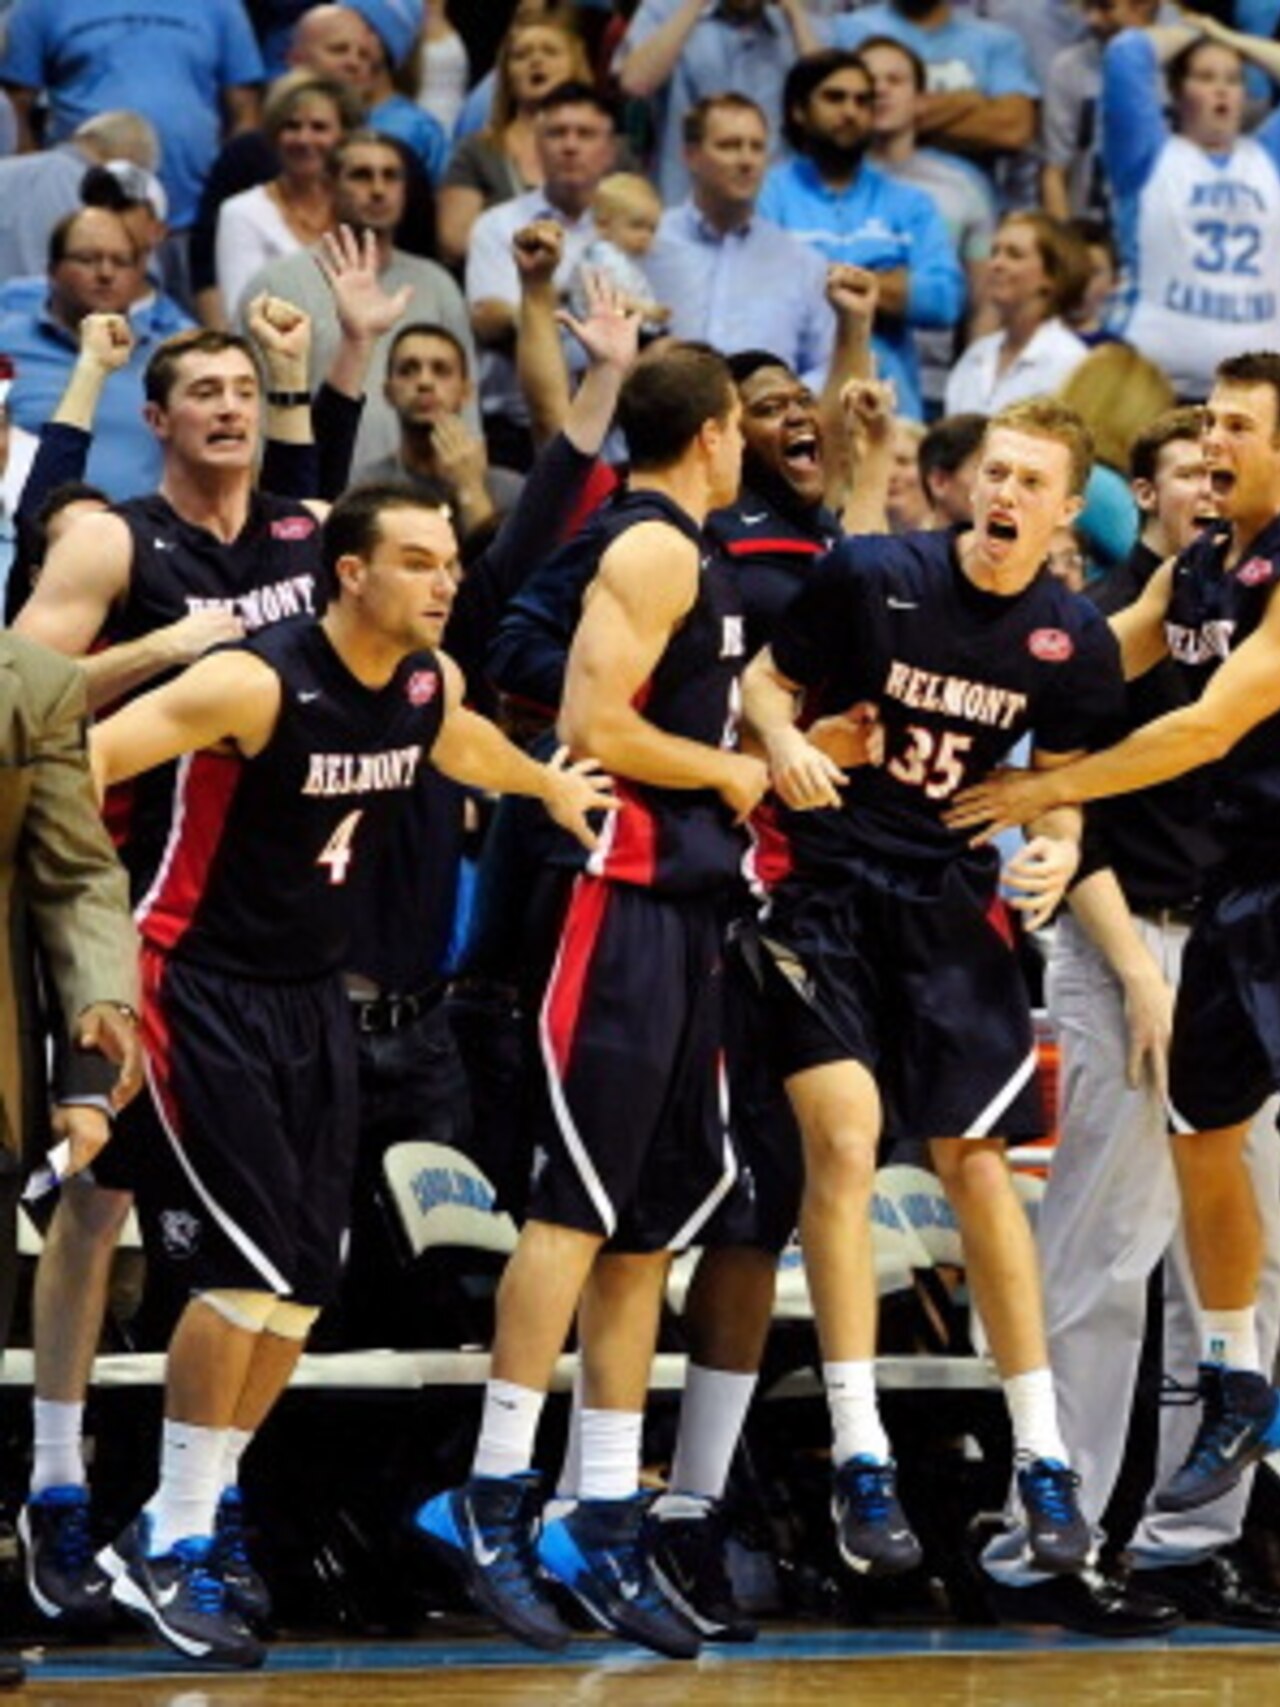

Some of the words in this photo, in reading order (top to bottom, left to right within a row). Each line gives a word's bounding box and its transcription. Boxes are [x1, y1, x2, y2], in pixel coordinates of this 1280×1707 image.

[1194, 218, 1262, 275] 32
[885, 660, 1027, 729] BELMONT
[302, 746, 422, 796] BELMONT
[888, 725, 973, 798] 35
[317, 810, 364, 884] 4
